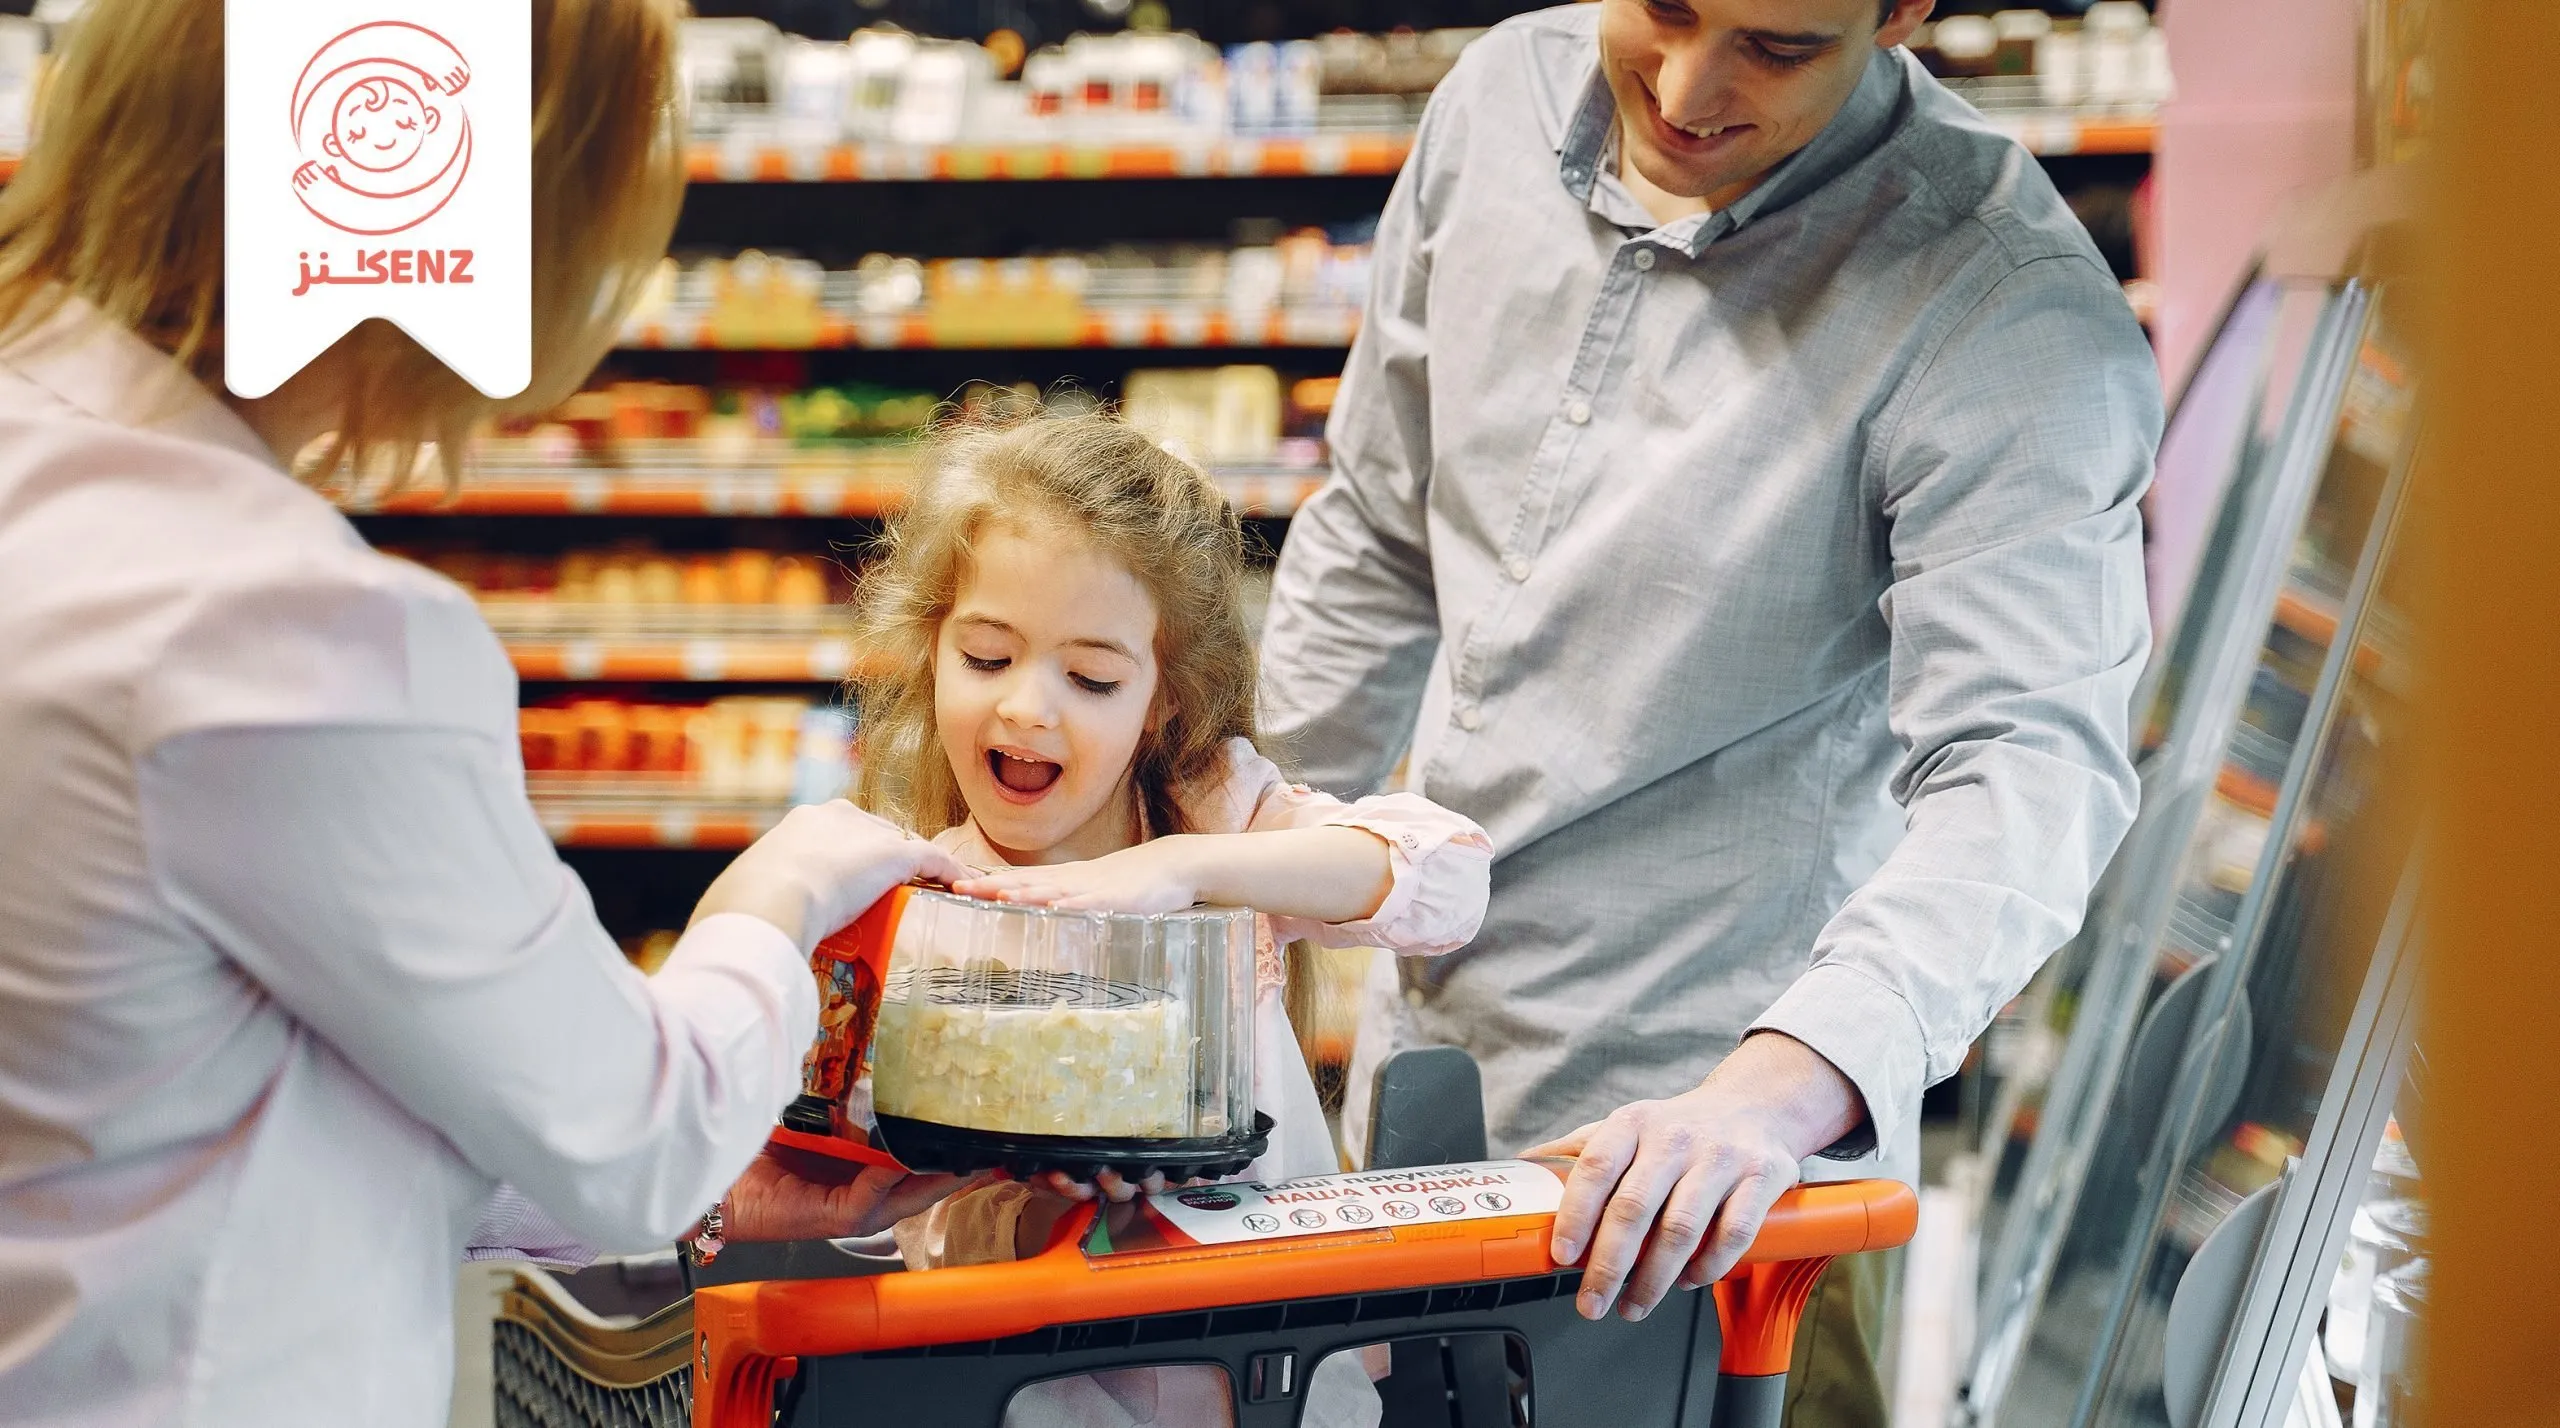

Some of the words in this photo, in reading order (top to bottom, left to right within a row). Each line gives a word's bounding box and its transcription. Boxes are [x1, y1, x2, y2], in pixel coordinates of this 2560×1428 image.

[1343, 1167, 1474, 1184] покупки
[1263, 1188, 1365, 1204] НАША
[1368, 1174, 1511, 1194] ПОДЯКА!
